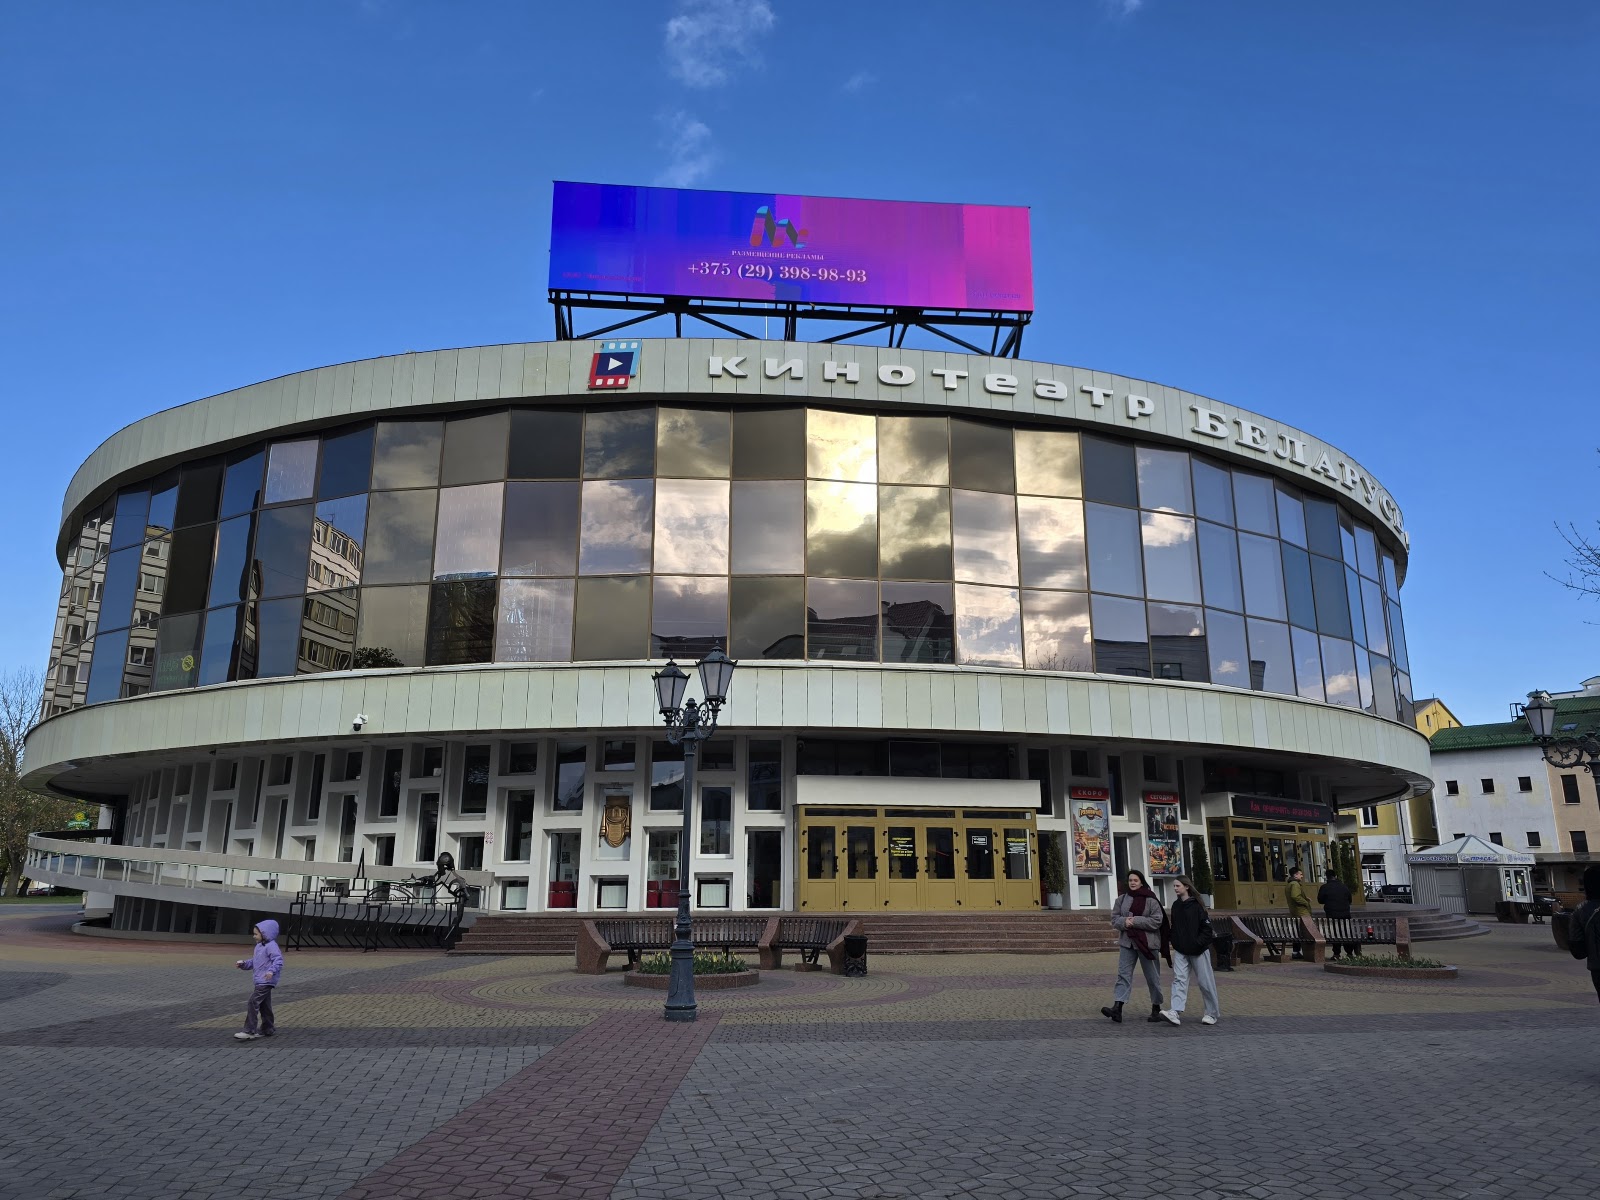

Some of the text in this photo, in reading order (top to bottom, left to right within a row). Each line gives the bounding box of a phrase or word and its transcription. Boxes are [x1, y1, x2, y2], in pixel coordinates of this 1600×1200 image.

[731, 249, 824, 262] РАЗМЕЩЕНИЕ РЕКЛАМЫ
[687, 261, 867, 284] +375 (29) 398-98-93
[1189, 403, 1404, 535] БЕЛАРУСЬ
[1077, 789, 1103, 797] СКОРО
[1150, 793, 1174, 802] СЕГОДНЯ
